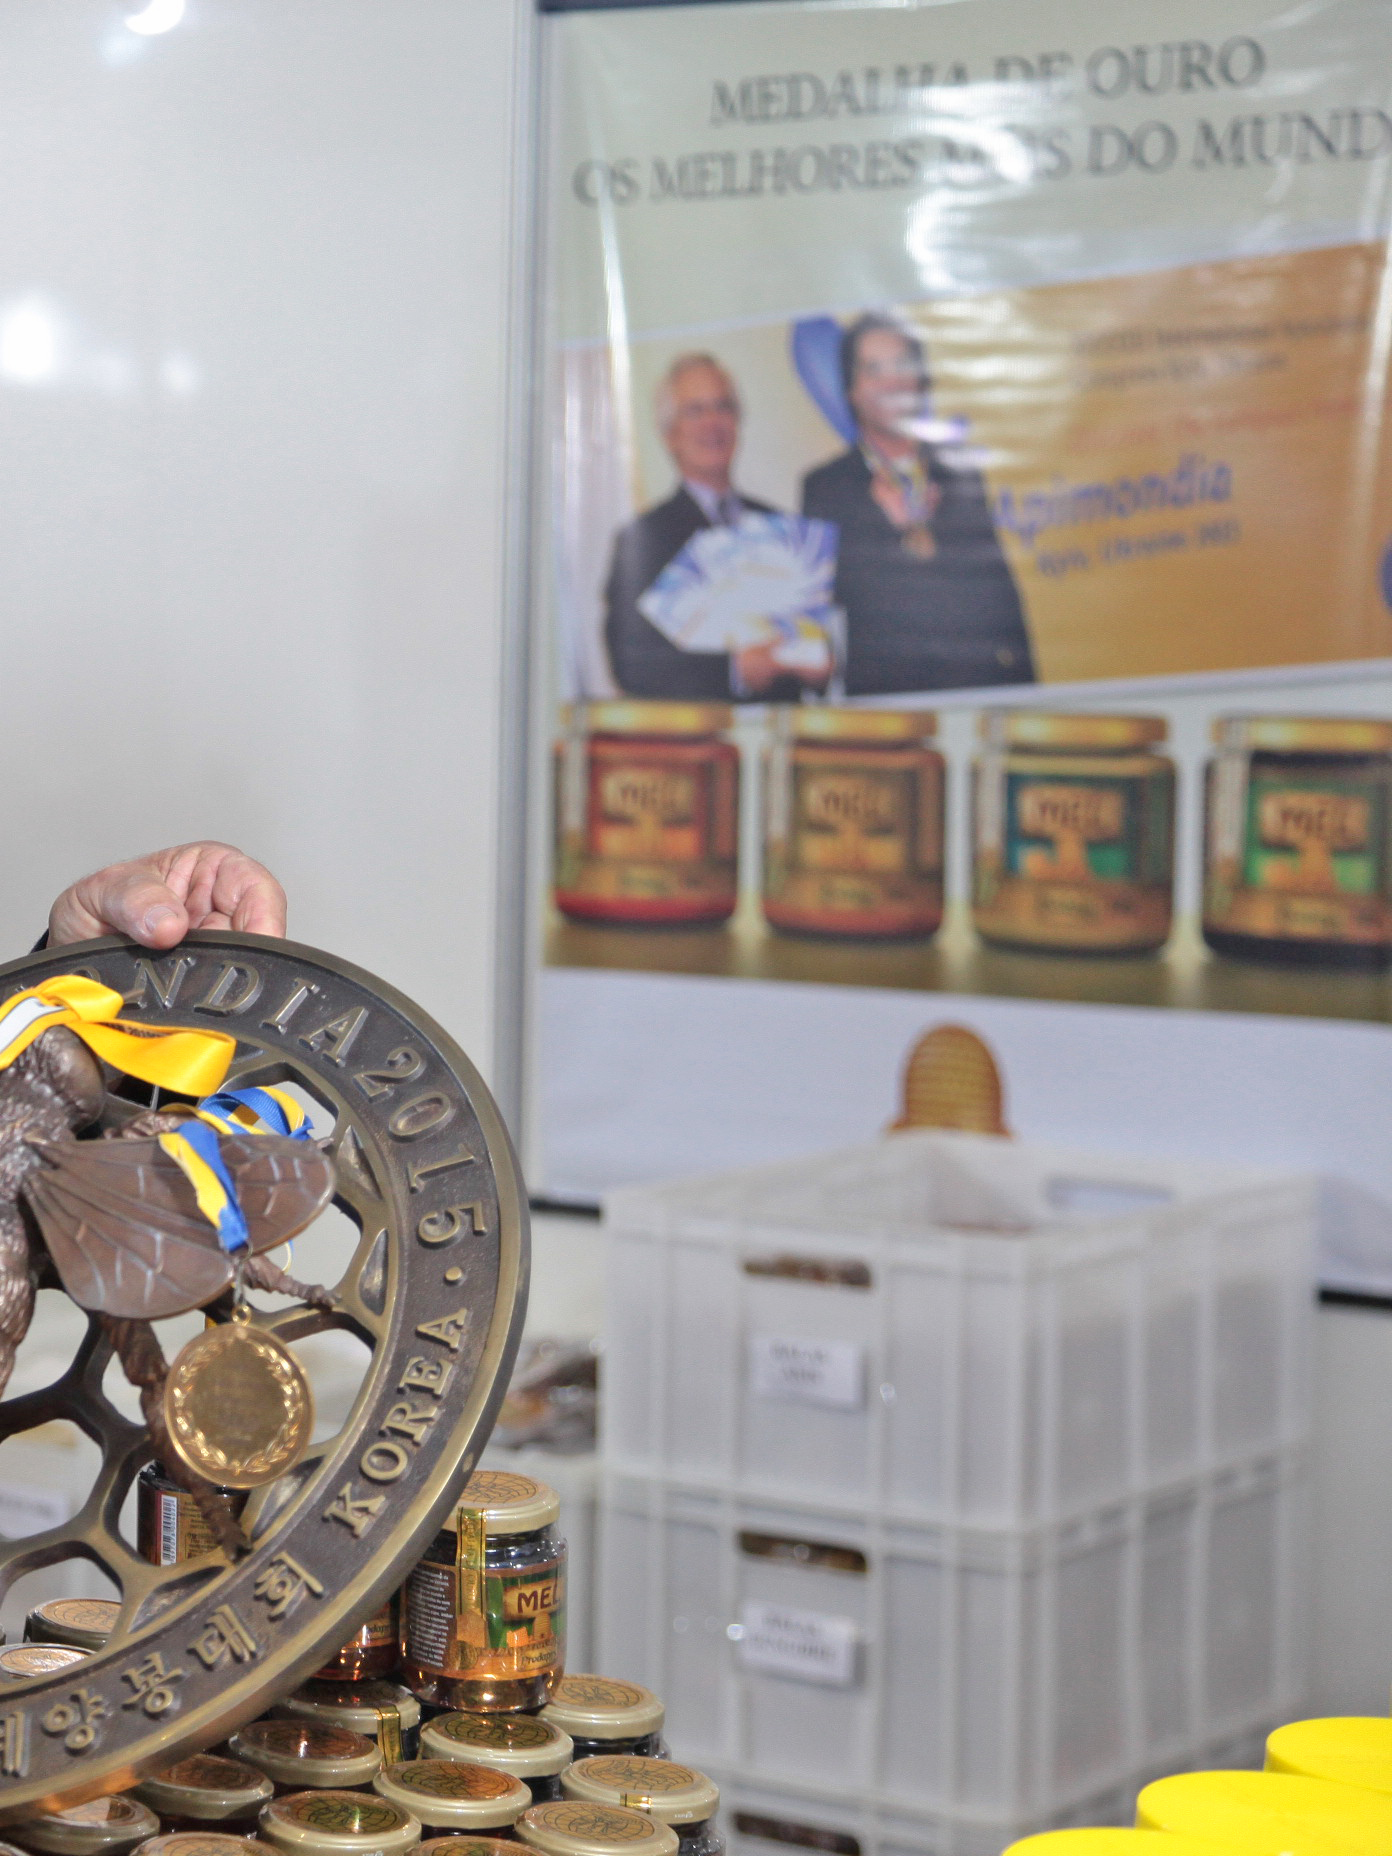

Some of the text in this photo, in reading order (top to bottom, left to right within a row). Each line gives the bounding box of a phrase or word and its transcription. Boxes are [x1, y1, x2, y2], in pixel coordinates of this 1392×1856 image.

[1085, 35, 1266, 101] OURO
[572, 156, 642, 209] OS
[650, 138, 925, 202] MELHORES
[1086, 119, 1179, 176] DO
[325, 1308, 469, 1540] KOREA
[517, 1584, 561, 1615] MEL
